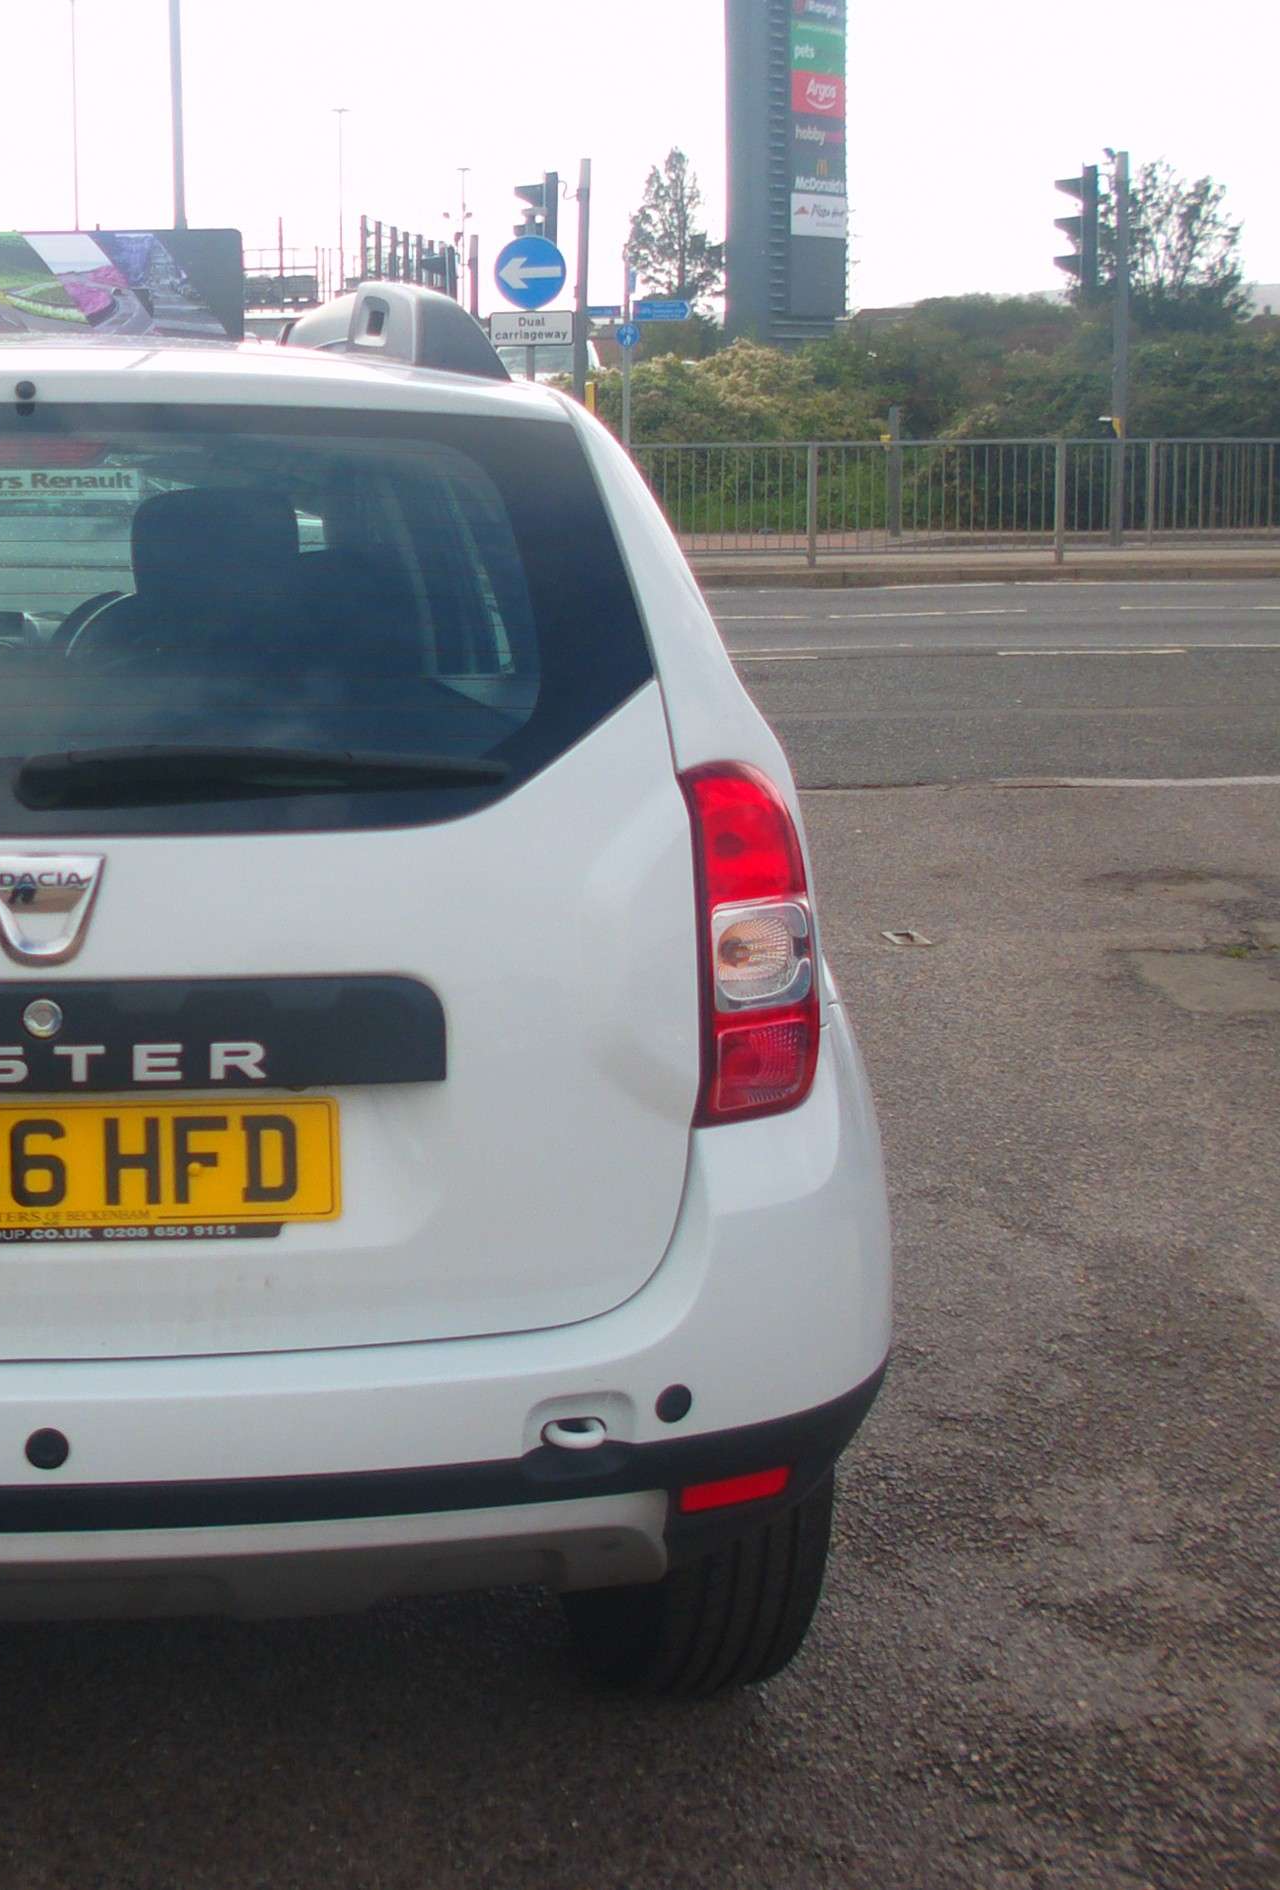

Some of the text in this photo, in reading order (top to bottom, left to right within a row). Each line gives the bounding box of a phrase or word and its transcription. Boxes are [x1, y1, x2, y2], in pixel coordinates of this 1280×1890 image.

[806, 78, 837, 101] Argos
[518, 317, 545, 327] Dual
[495, 327, 568, 341] carriageway
[31, 471, 134, 489] Renault
[105, 1114, 299, 1206] HFD
[66, 1210, 151, 1221] BECKENHAM
[103, 1227, 149, 1238] 0208
[153, 1226, 188, 1237] 650
[193, 1225, 237, 1236] 9151
